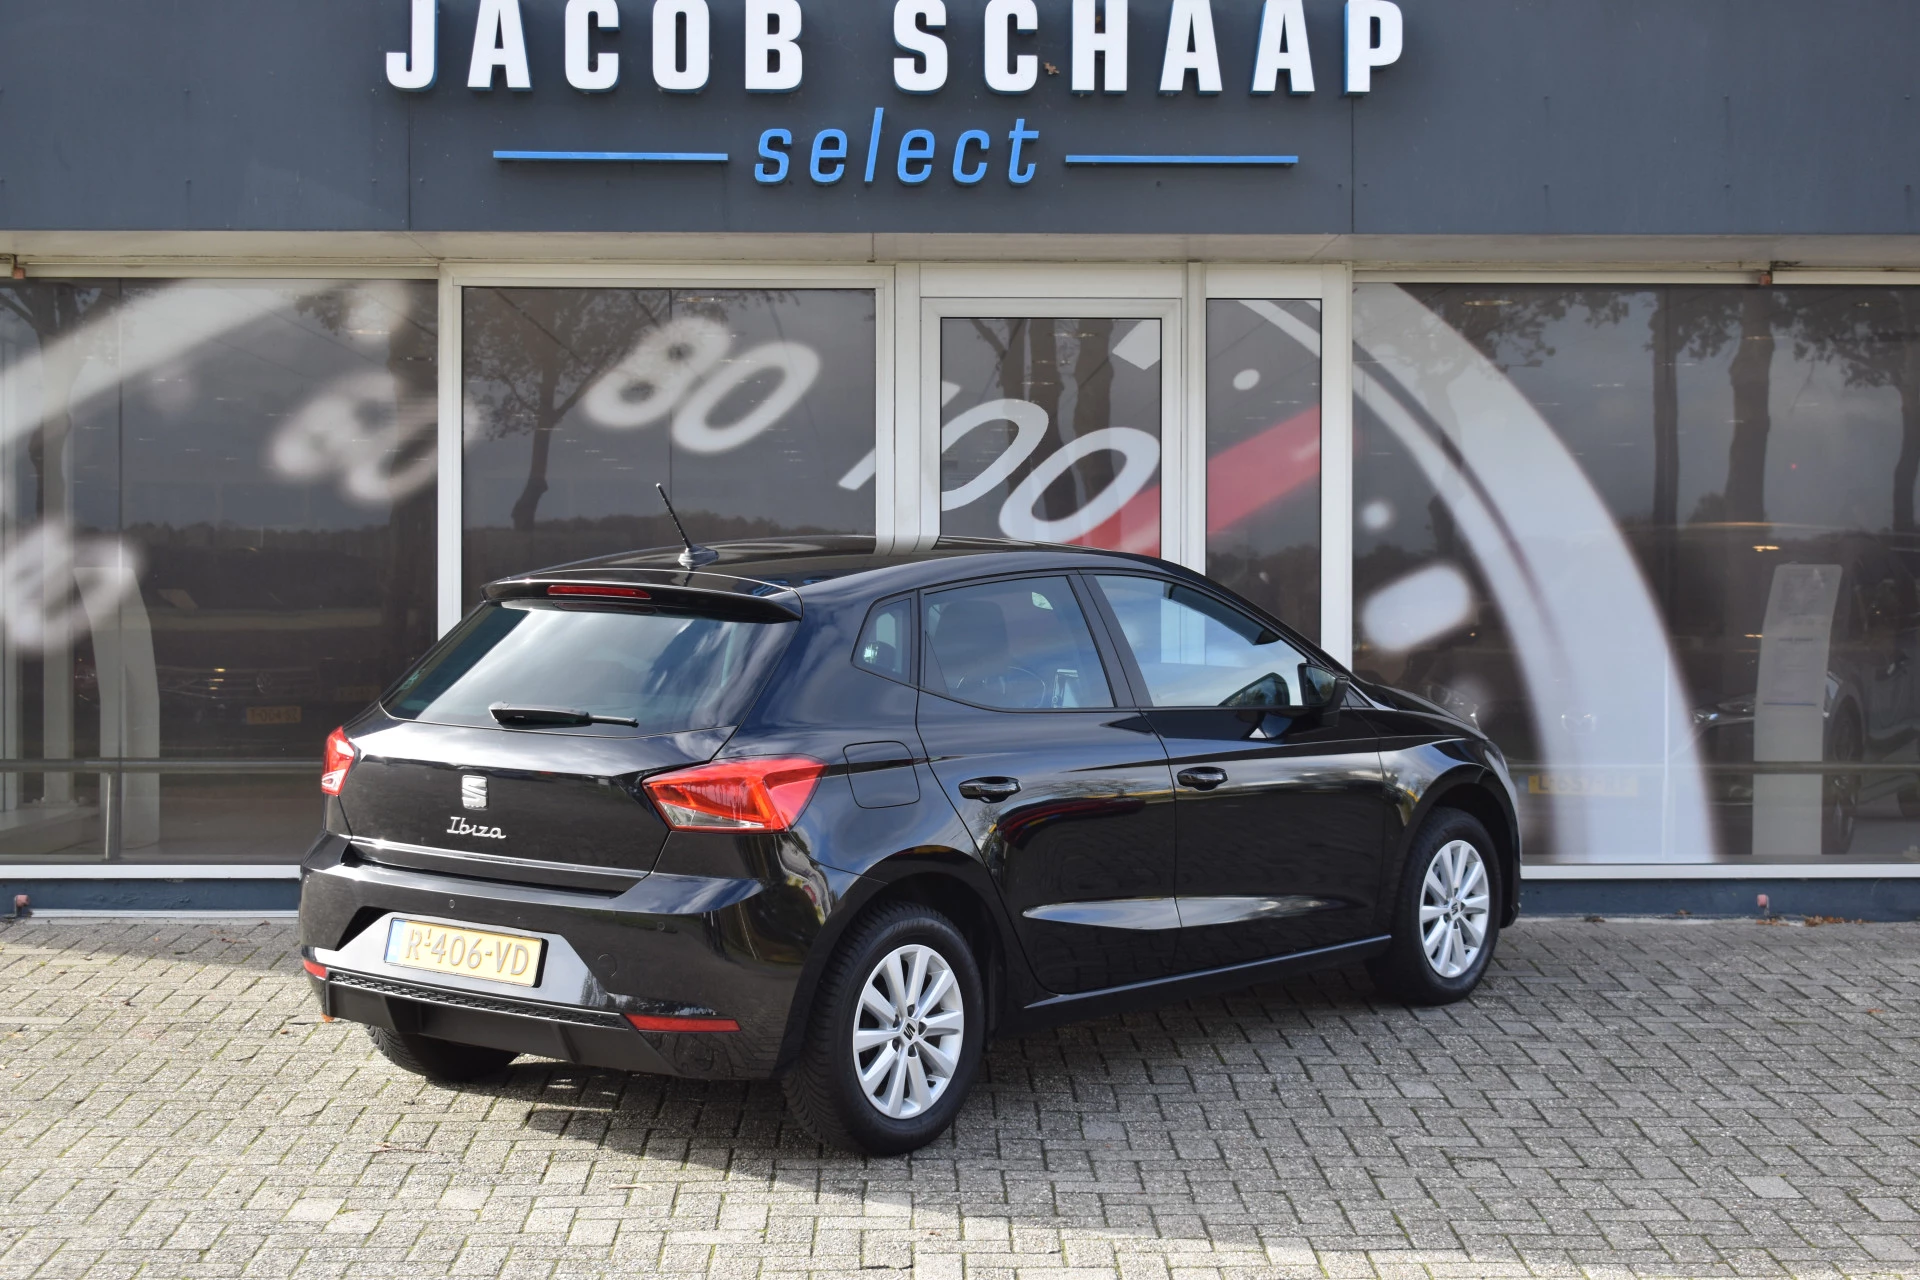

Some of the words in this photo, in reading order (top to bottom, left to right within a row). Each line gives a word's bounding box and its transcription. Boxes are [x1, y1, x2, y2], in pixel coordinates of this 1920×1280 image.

[386, 0, 803, 92] JACOB
[893, 0, 1403, 95] SCHAAP
[754, 107, 1040, 185] select
[446, 816, 507, 839] Ibiza
